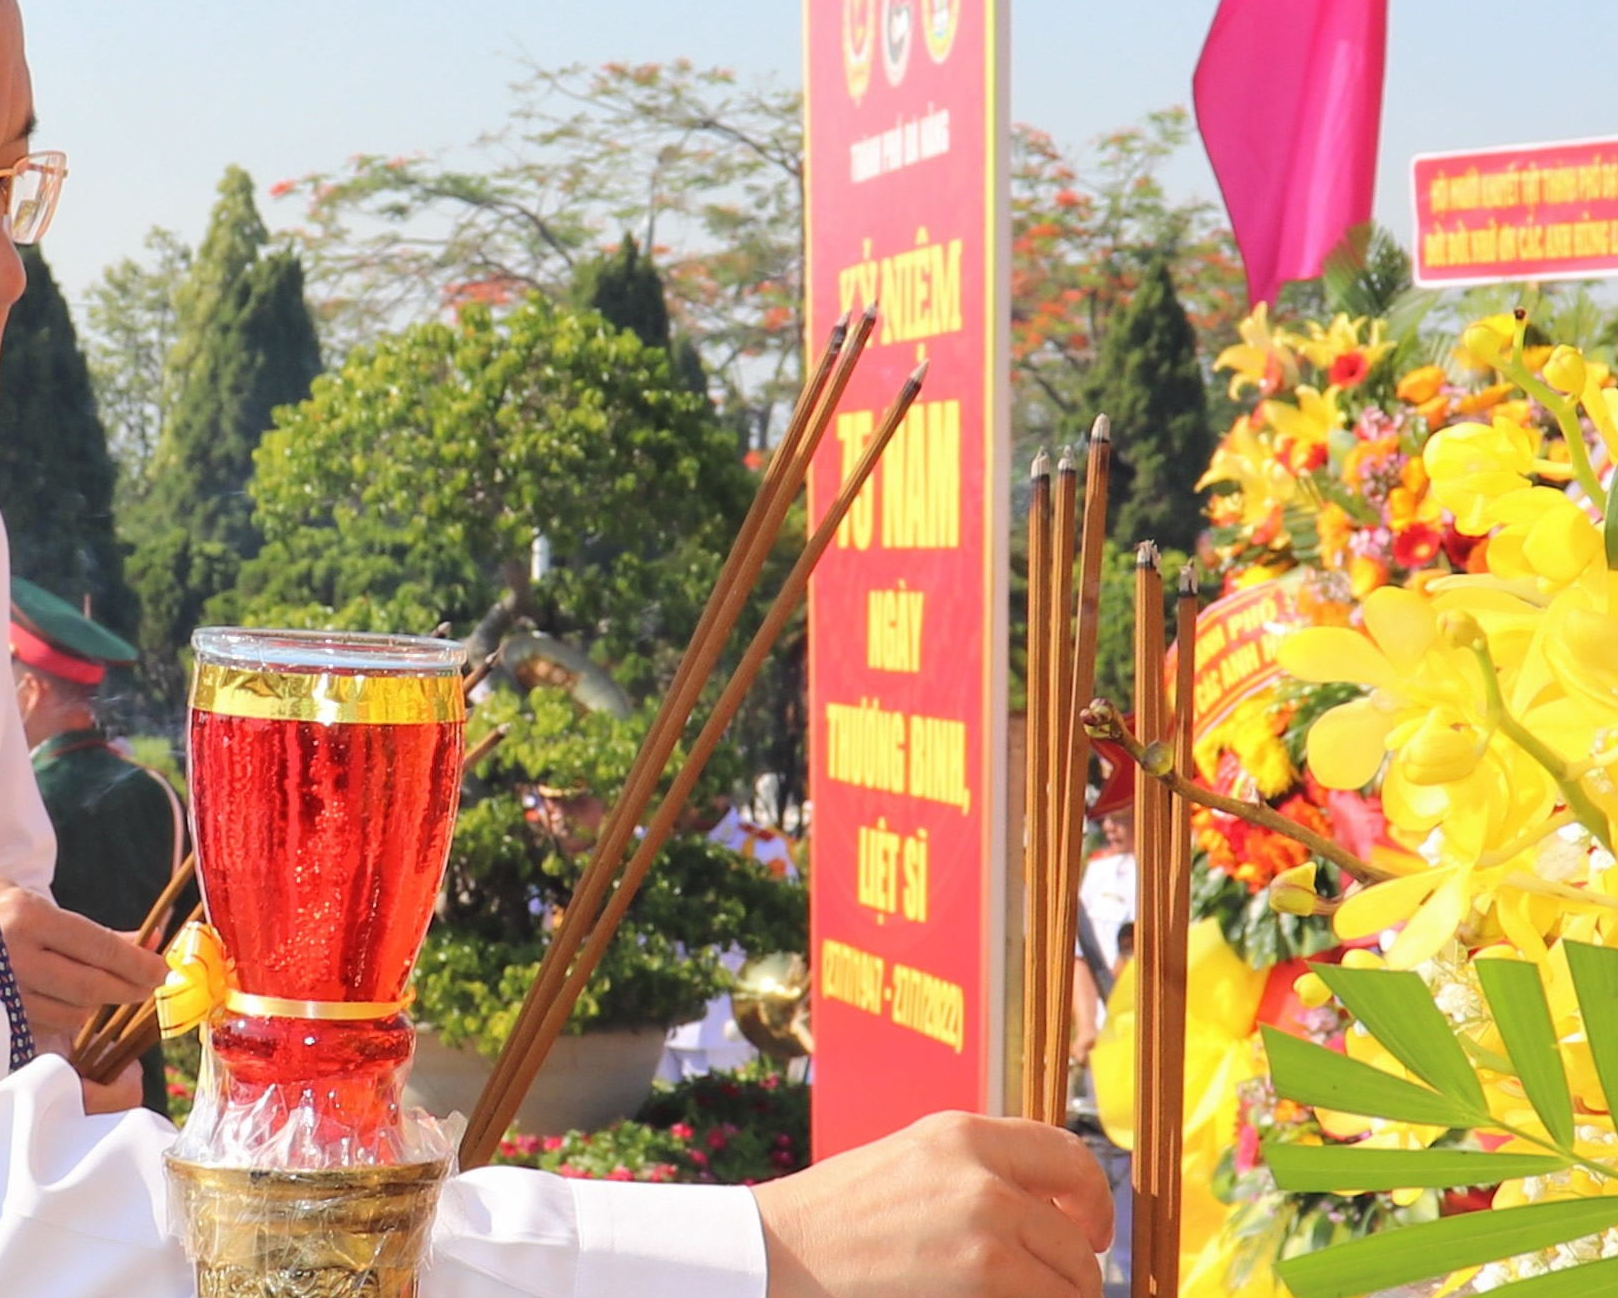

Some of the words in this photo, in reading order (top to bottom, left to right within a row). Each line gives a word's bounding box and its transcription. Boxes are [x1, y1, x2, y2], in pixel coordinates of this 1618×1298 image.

[880, 225, 963, 362] NIỆM
[868, 578, 923, 673] NGÀY
[858, 816, 899, 925] LIỆT
[903, 827, 927, 922] SĨ
